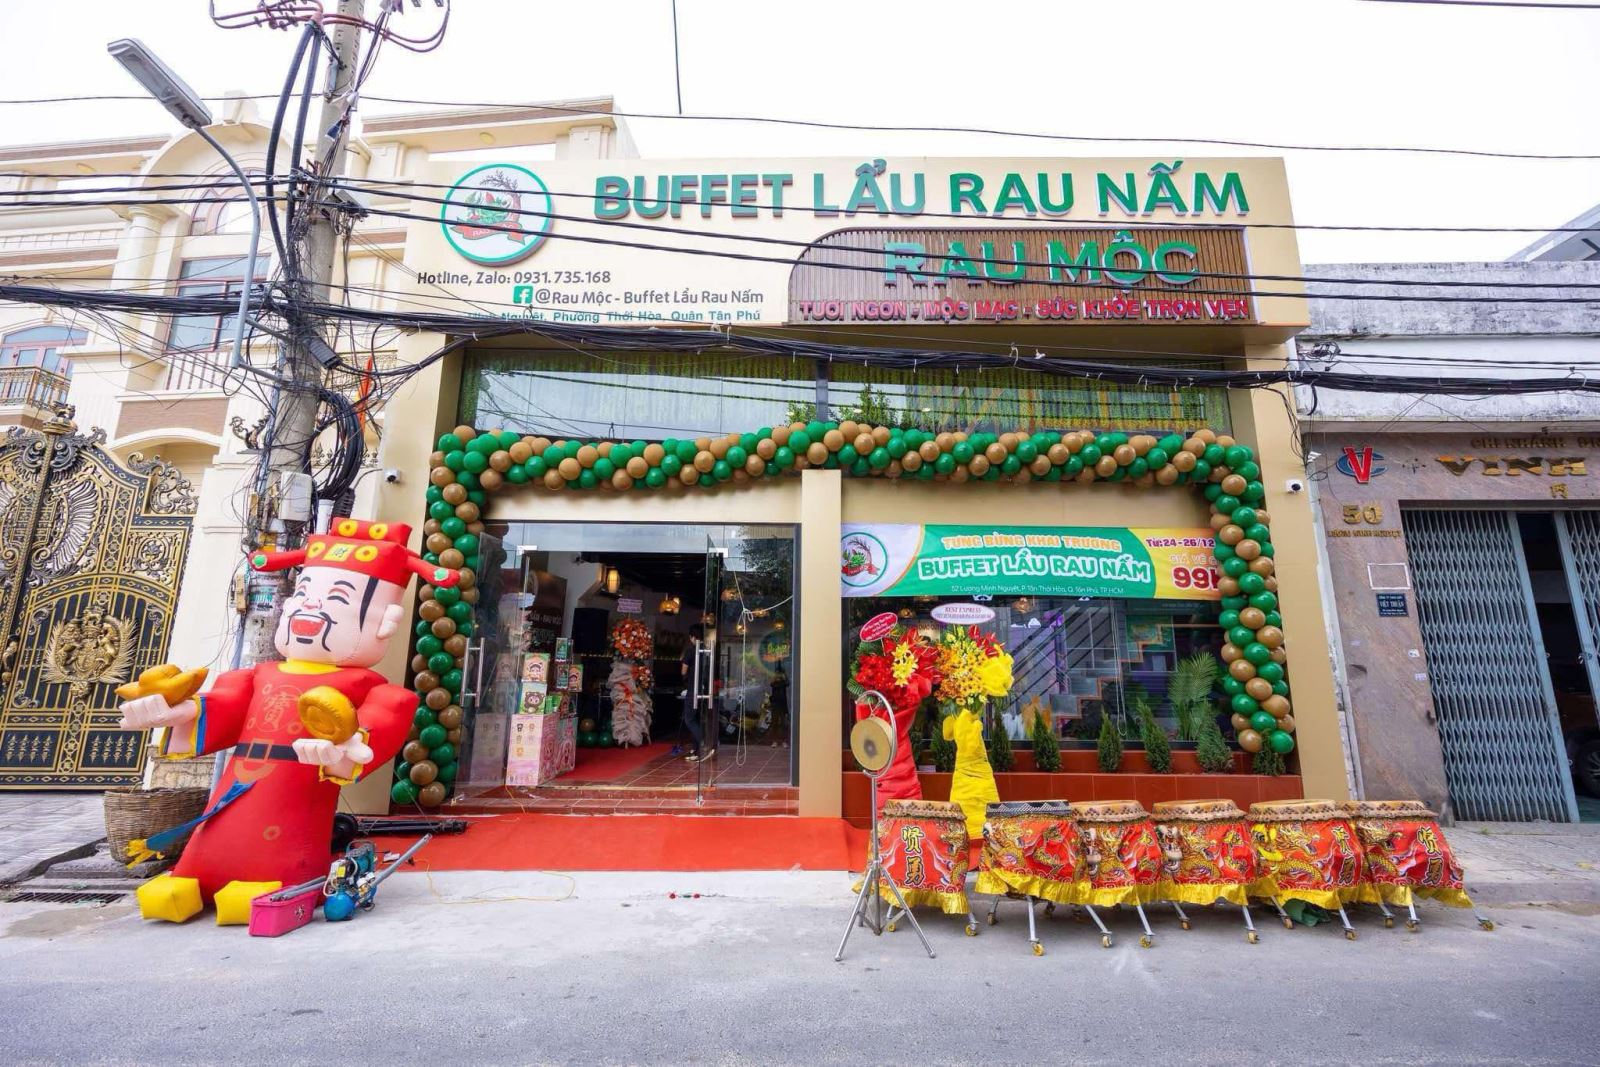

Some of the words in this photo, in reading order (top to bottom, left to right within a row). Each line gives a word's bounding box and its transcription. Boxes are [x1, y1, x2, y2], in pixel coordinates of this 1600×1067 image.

[594, 173, 793, 219] BUFFET
[813, 158, 926, 217] LẨU
[949, 172, 1075, 216] RAU
[1096, 160, 1250, 216] NẤM
[885, 241, 1025, 287] RAU
[1047, 230, 1199, 293] MỘC
[418, 271, 472, 286] Hotline,
[475, 271, 511, 284] Zalo:
[514, 270, 611, 284] 0931.735.168
[535, 288, 578, 304] @Rau
[582, 291, 612, 306] Mộc
[624, 290, 670, 304] Buffet
[673, 287, 698, 304] Lẩu
[701, 290, 728, 304] Rau
[731, 288, 764, 304] Nấm
[708, 310, 731, 320] Tân
[737, 309, 761, 320] Phú
[851, 301, 907, 321] NGON
[923, 297, 969, 323] MỘC
[974, 299, 1018, 323] MẠC
[1143, 299, 1200, 322] TRỌN
[1205, 299, 1249, 322] VẸN
[1436, 455, 1587, 476] VINH
[1343, 504, 1384, 525] 50
[1025, 535, 1061, 547] KHAI
[918, 555, 999, 580] BUFFET
[1001, 547, 1050, 576] LẨU
[1051, 555, 1098, 577] RAU
[1100, 554, 1151, 583] NẤM
